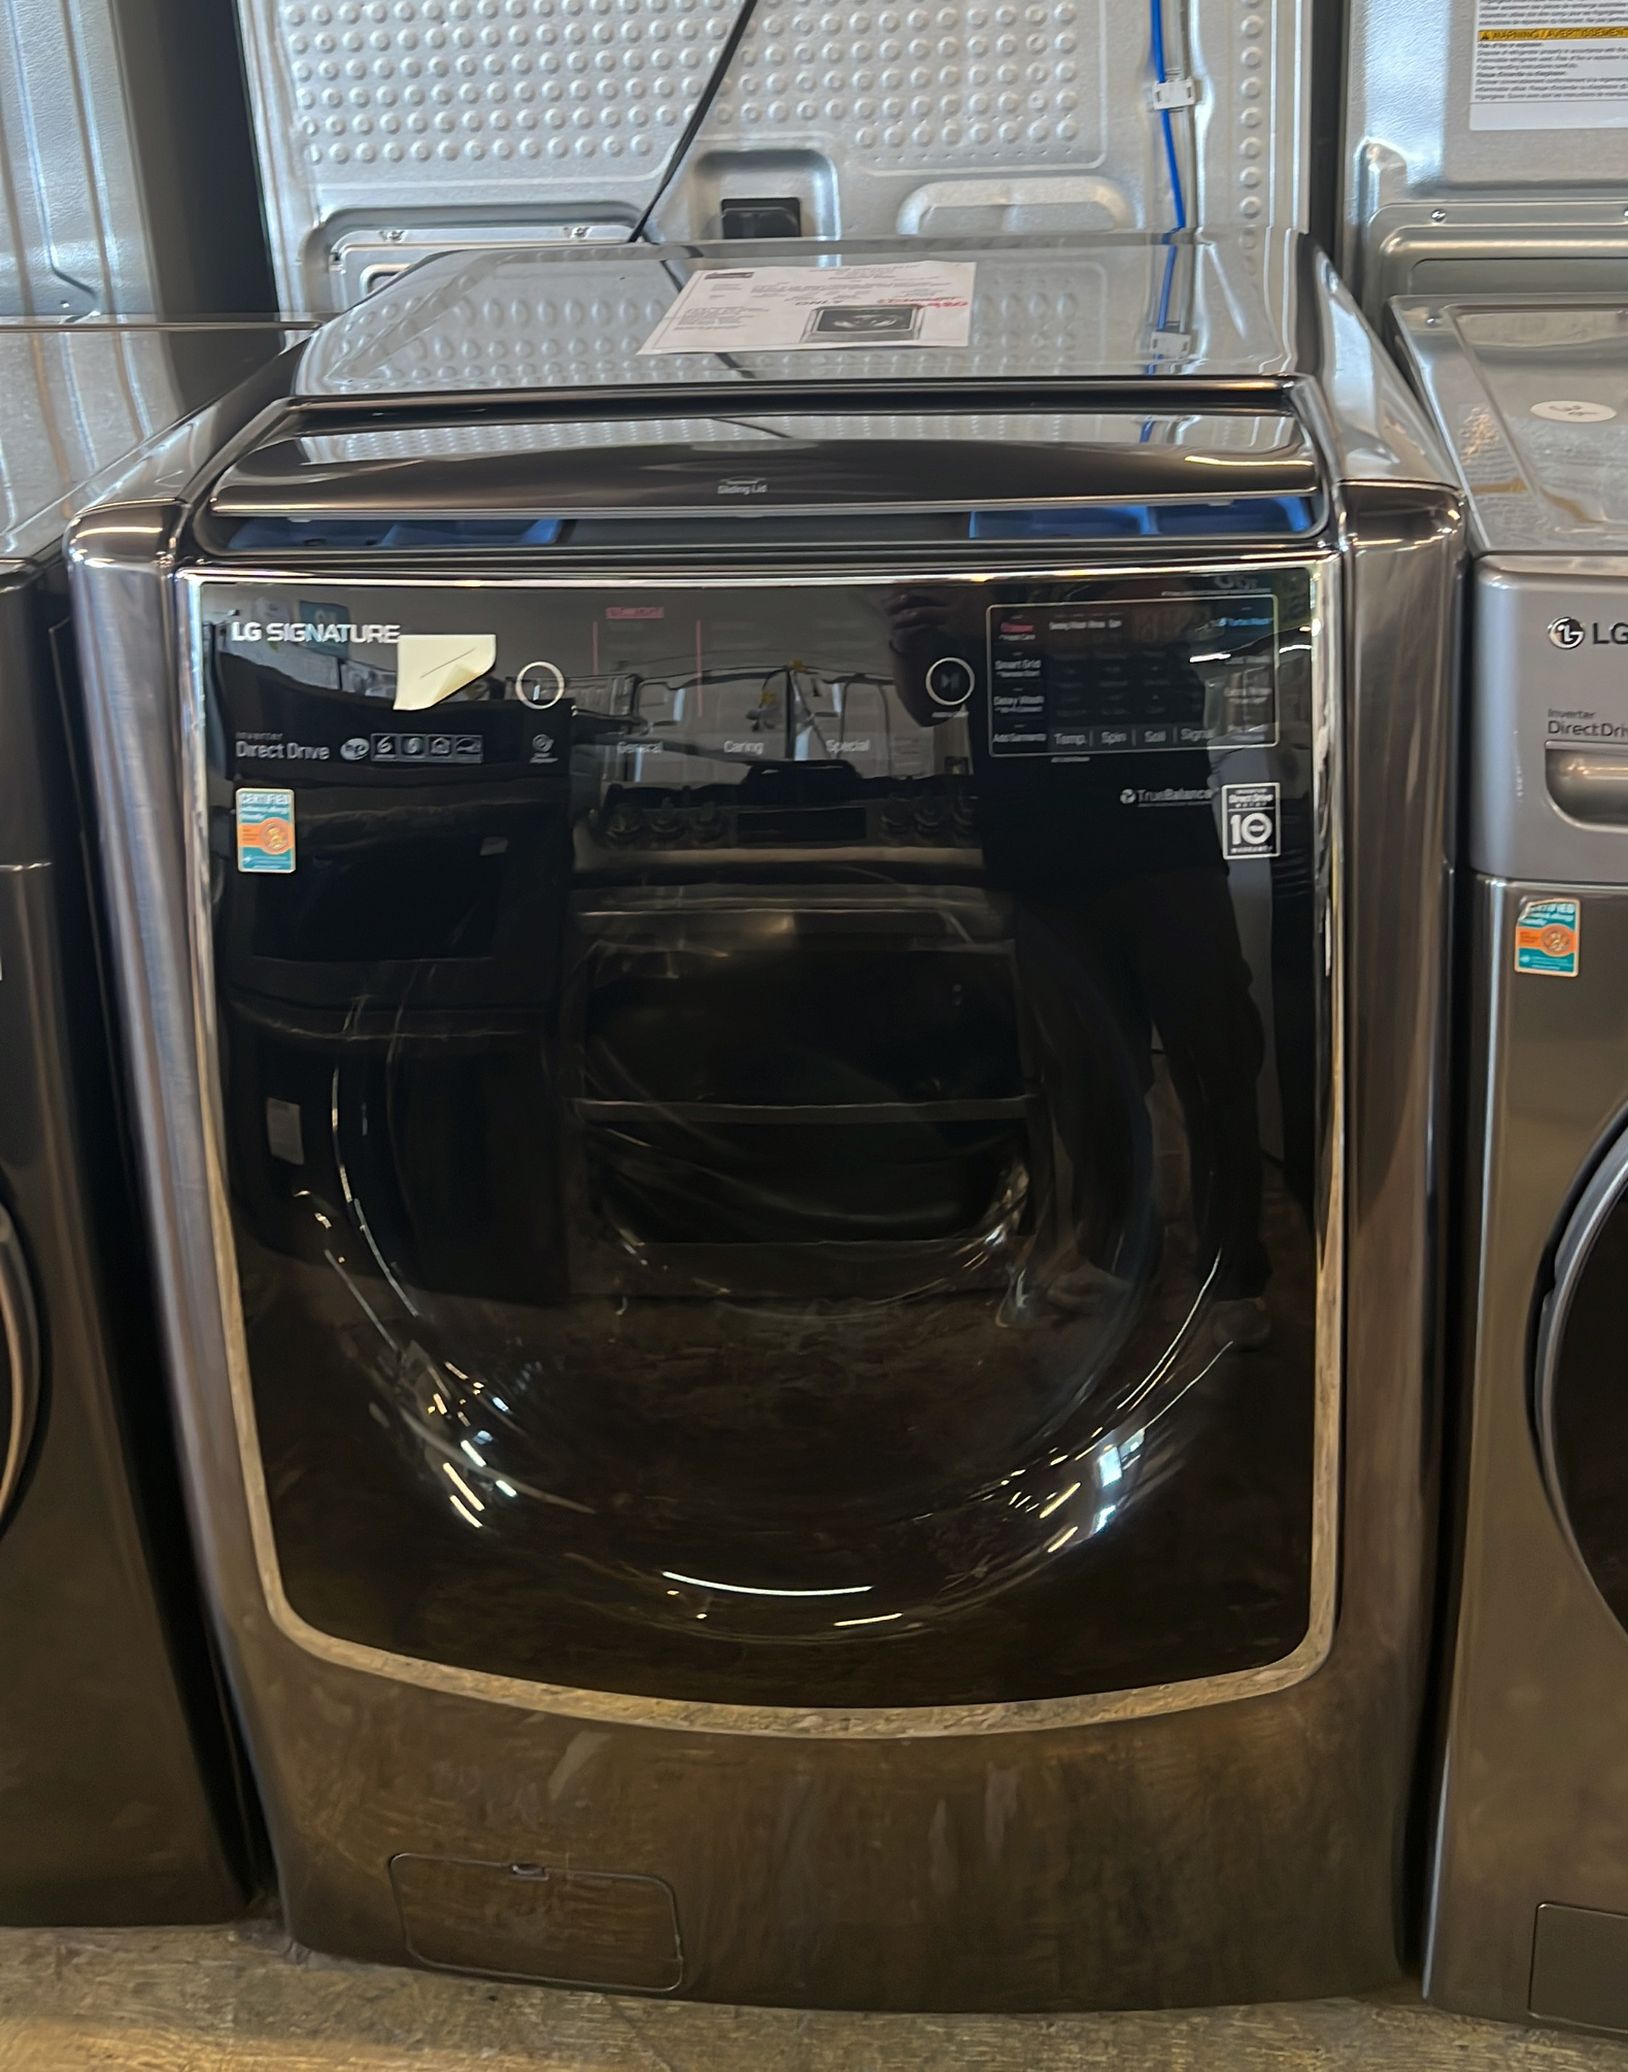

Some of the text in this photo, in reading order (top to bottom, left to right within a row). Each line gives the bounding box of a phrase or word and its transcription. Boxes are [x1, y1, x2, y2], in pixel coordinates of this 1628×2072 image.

[232, 621, 400, 643] LG SIGNATURE
[1593, 623, 1628, 645] LG
[724, 740, 764, 755] Caring
[1230, 812, 1273, 846] 10
